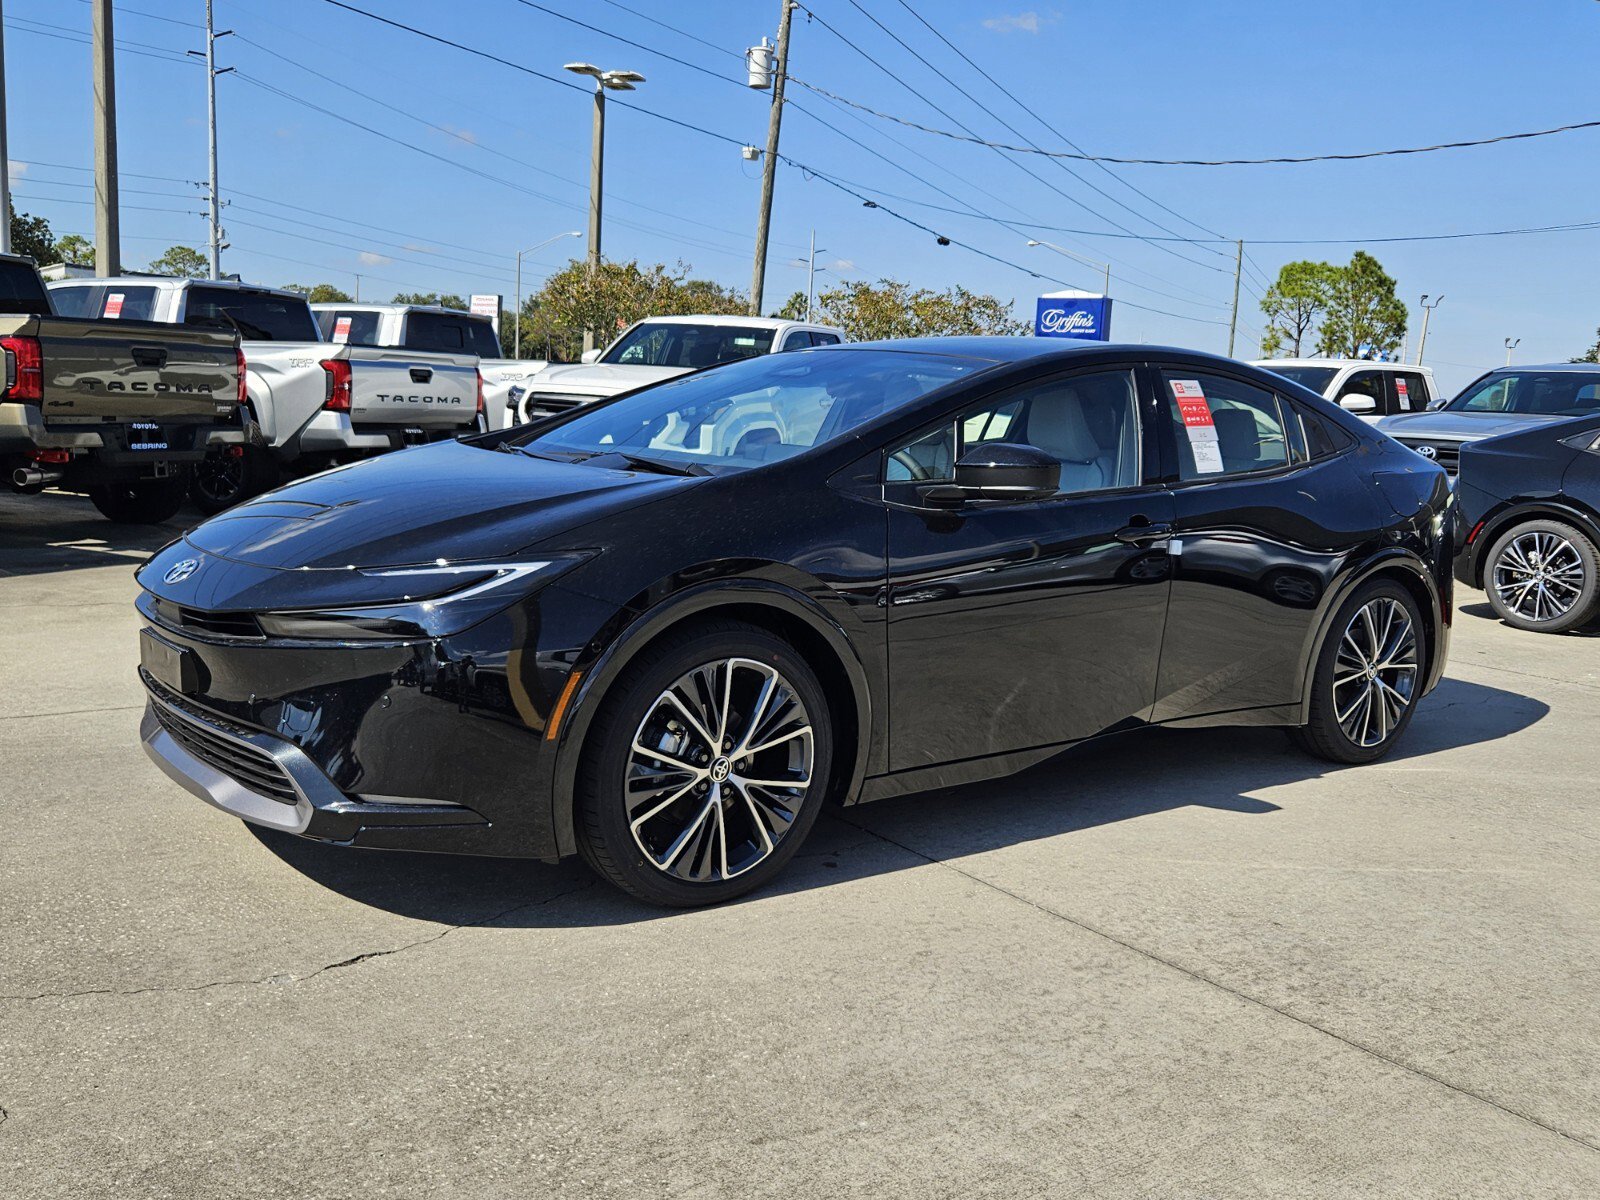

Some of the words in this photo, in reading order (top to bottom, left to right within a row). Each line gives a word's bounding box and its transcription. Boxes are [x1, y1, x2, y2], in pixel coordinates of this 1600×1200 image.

[1041, 309, 1094, 333] Griffin's
[81, 380, 213, 393] TACOMA
[376, 394, 462, 405] TACOMA
